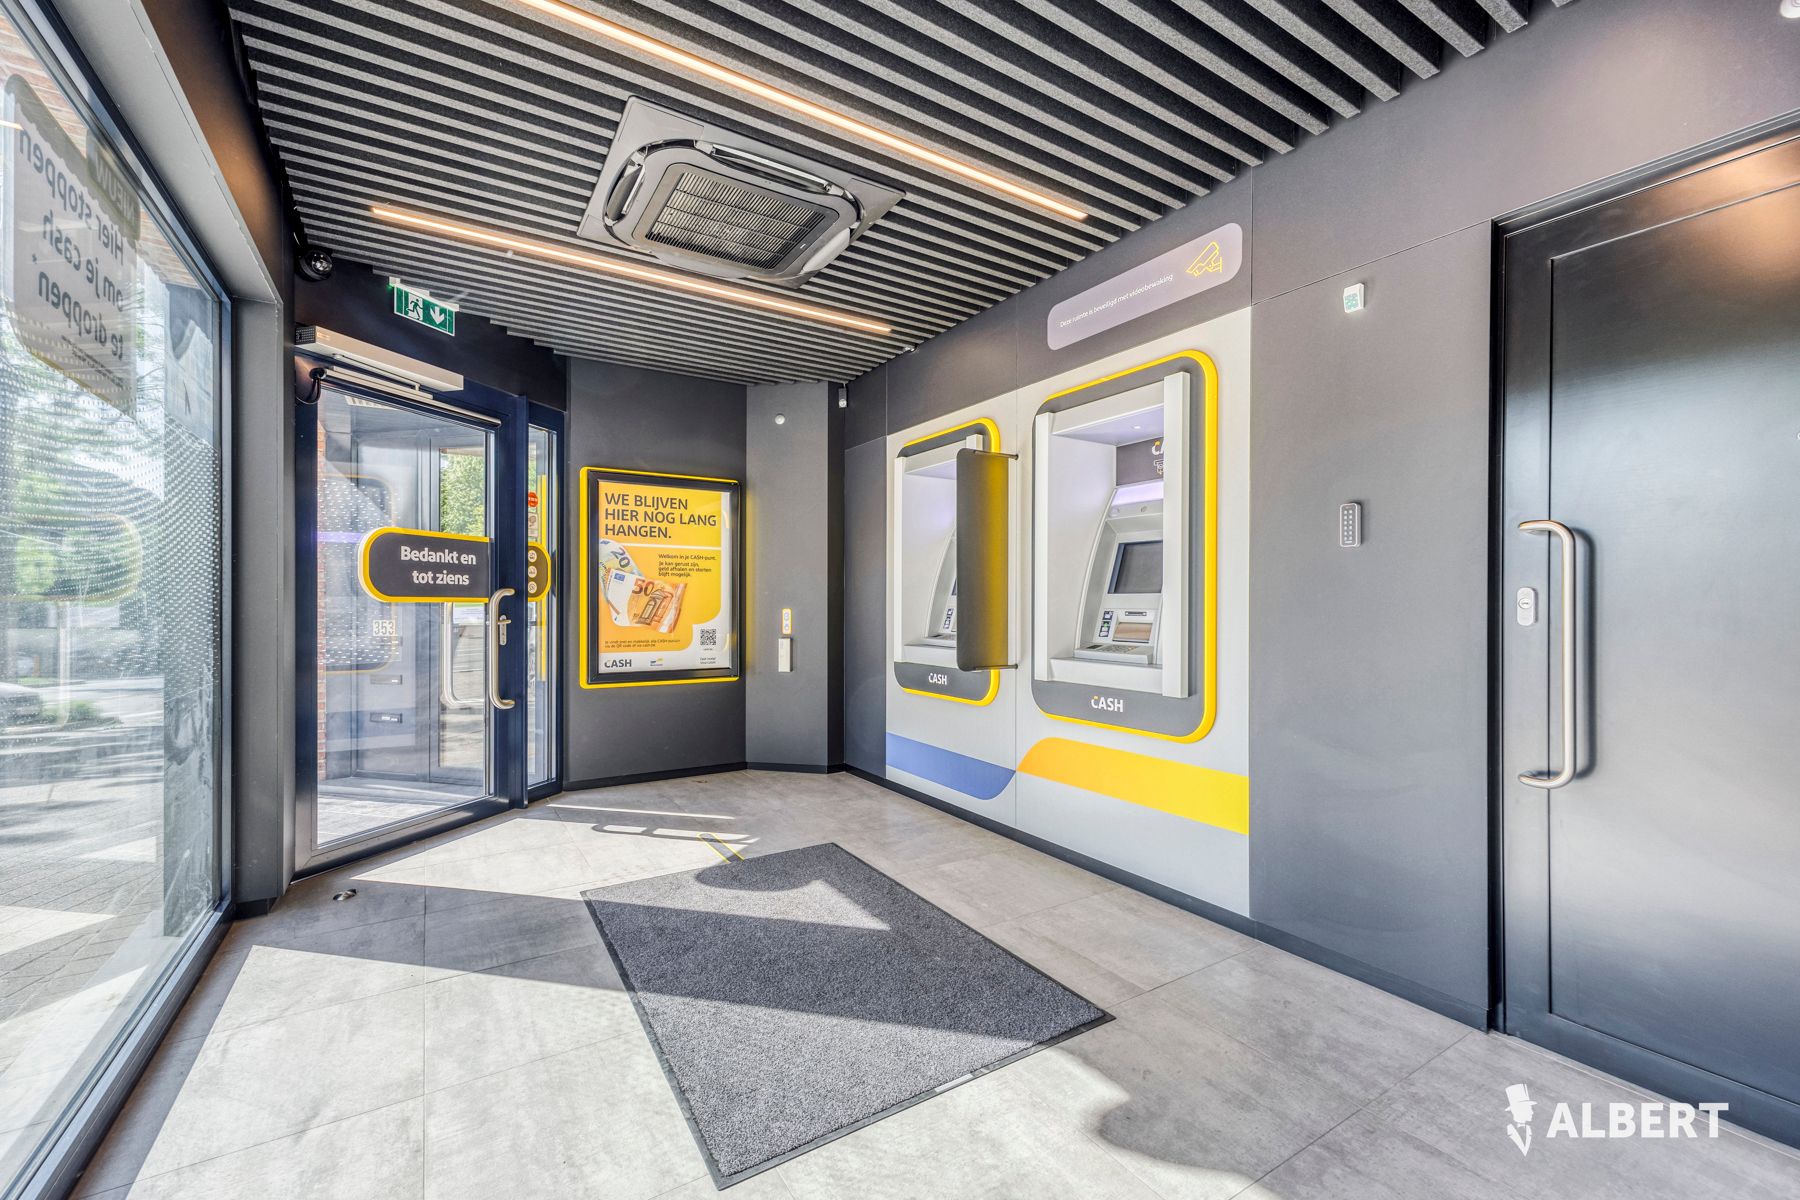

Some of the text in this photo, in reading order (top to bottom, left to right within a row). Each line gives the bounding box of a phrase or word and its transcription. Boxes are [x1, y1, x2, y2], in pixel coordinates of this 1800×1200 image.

[1117, 293, 1129, 303] met
[1129, 274, 1174, 297] videobewaking
[605, 492, 688, 510] WE BLIJVEN
[605, 508, 717, 526] HIER NOG LANG
[605, 523, 672, 539] HANGEN.
[400, 545, 476, 565] Bedankt en
[610, 547, 631, 569] 20
[412, 569, 470, 585] tot ziens
[632, 577, 655, 597] 50
[374, 621, 394, 635] 353
[604, 658, 632, 668] CASH
[928, 672, 947, 685] CASH
[1091, 695, 1124, 713] CASH
